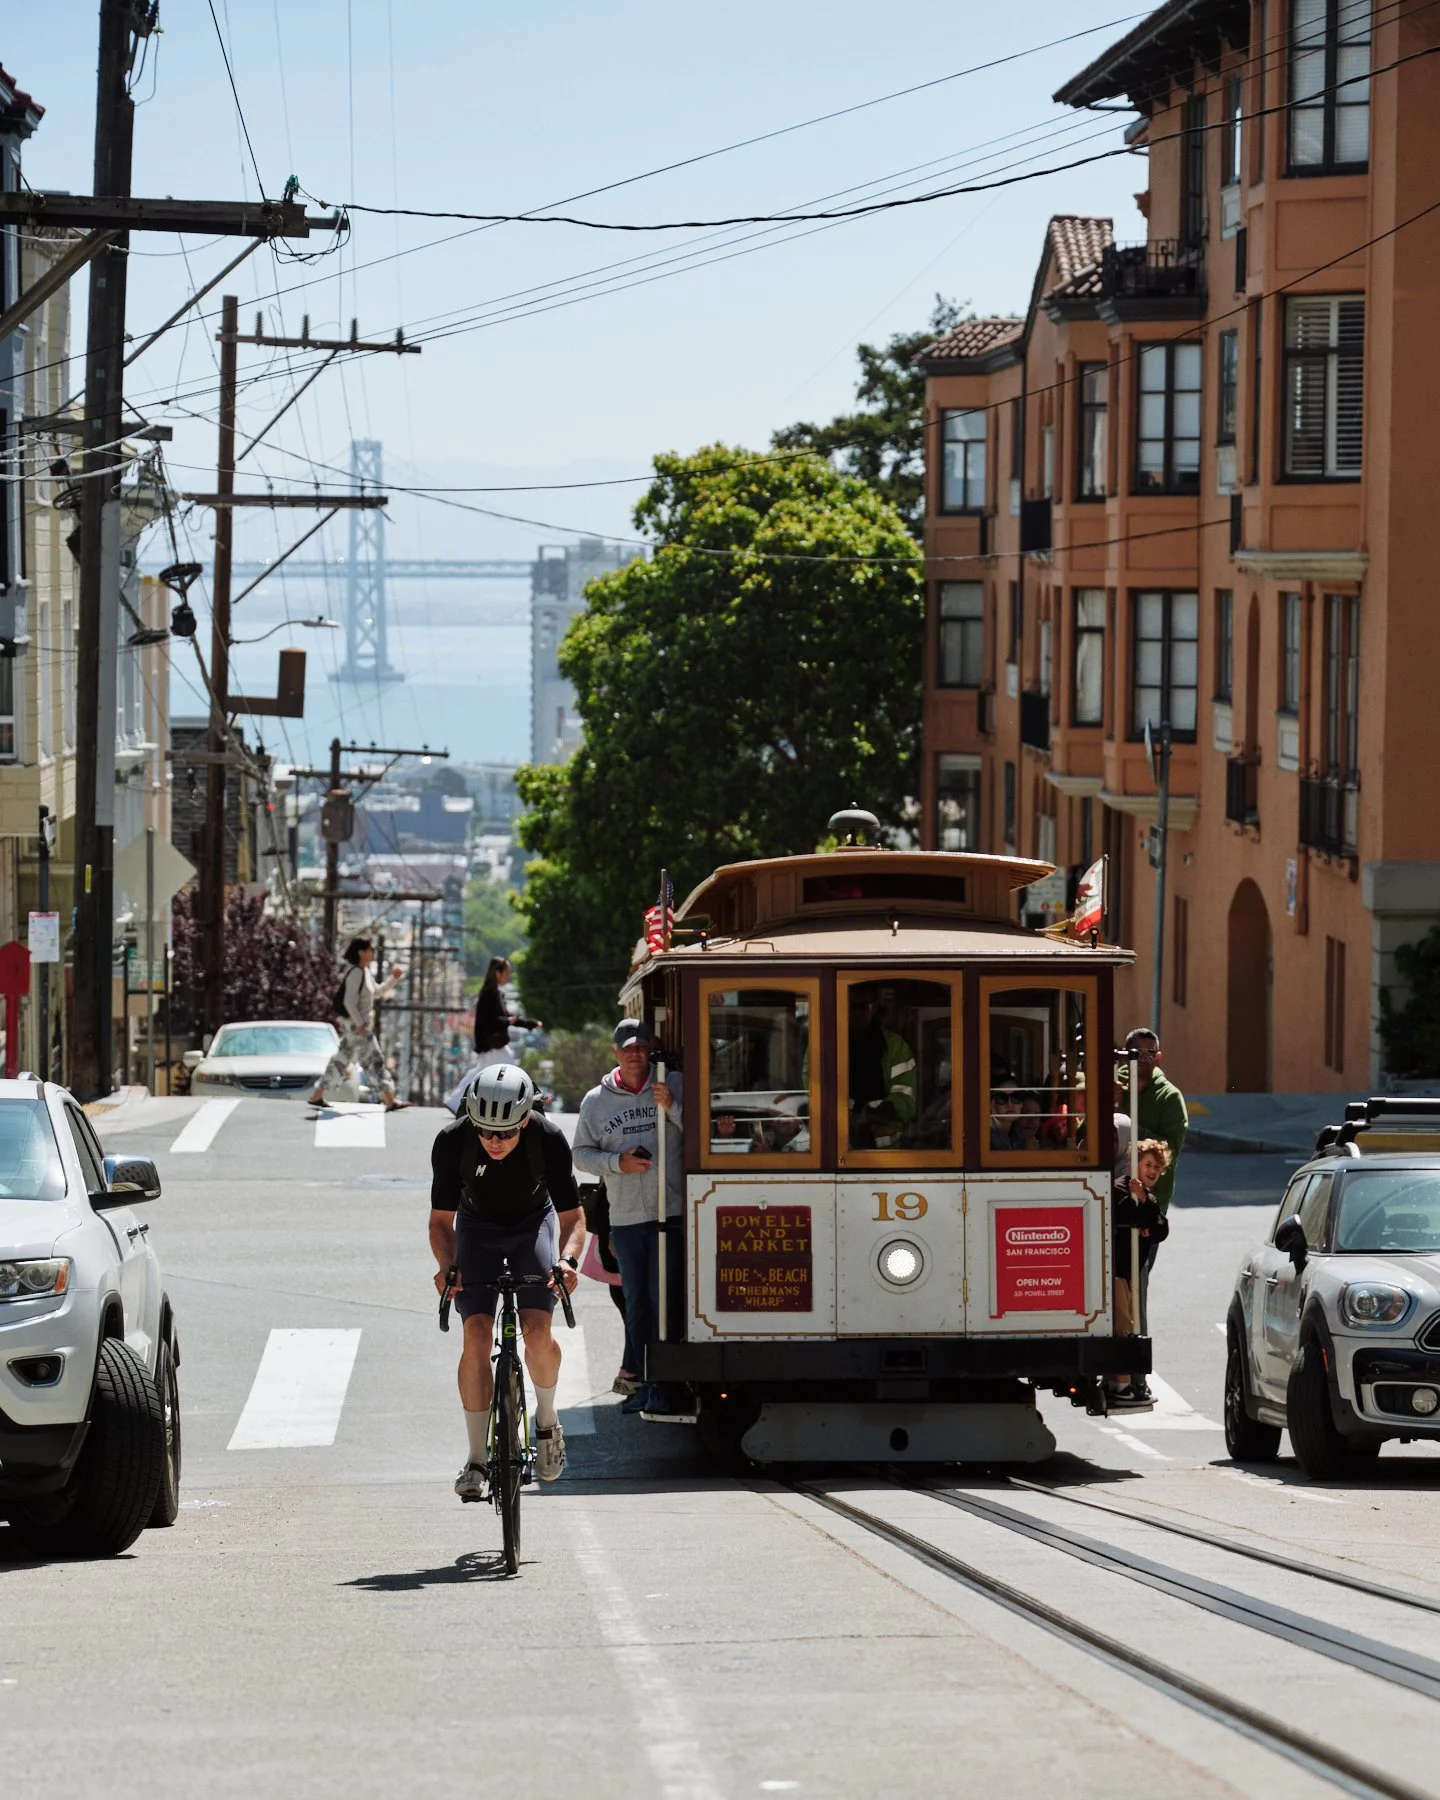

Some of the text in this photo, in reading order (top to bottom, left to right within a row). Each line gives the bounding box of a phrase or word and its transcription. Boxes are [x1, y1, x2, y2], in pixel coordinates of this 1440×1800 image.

[605, 1106, 657, 1134] SAN FRANCI
[872, 1191, 928, 1221] 19
[721, 1215, 806, 1228] POWELL
[744, 1229, 786, 1238] AND
[1011, 1231, 1064, 1240] Nintendo
[720, 1239, 808, 1251] MARKET
[1006, 1247, 1070, 1256] SAN FRANCISCO
[720, 1268, 750, 1282] HYDE
[769, 1268, 807, 1282] BEACH
[1016, 1278, 1062, 1286] OPEN NOW
[728, 1285, 800, 1296] FISHERMANS
[745, 1297, 784, 1307] WHARF
